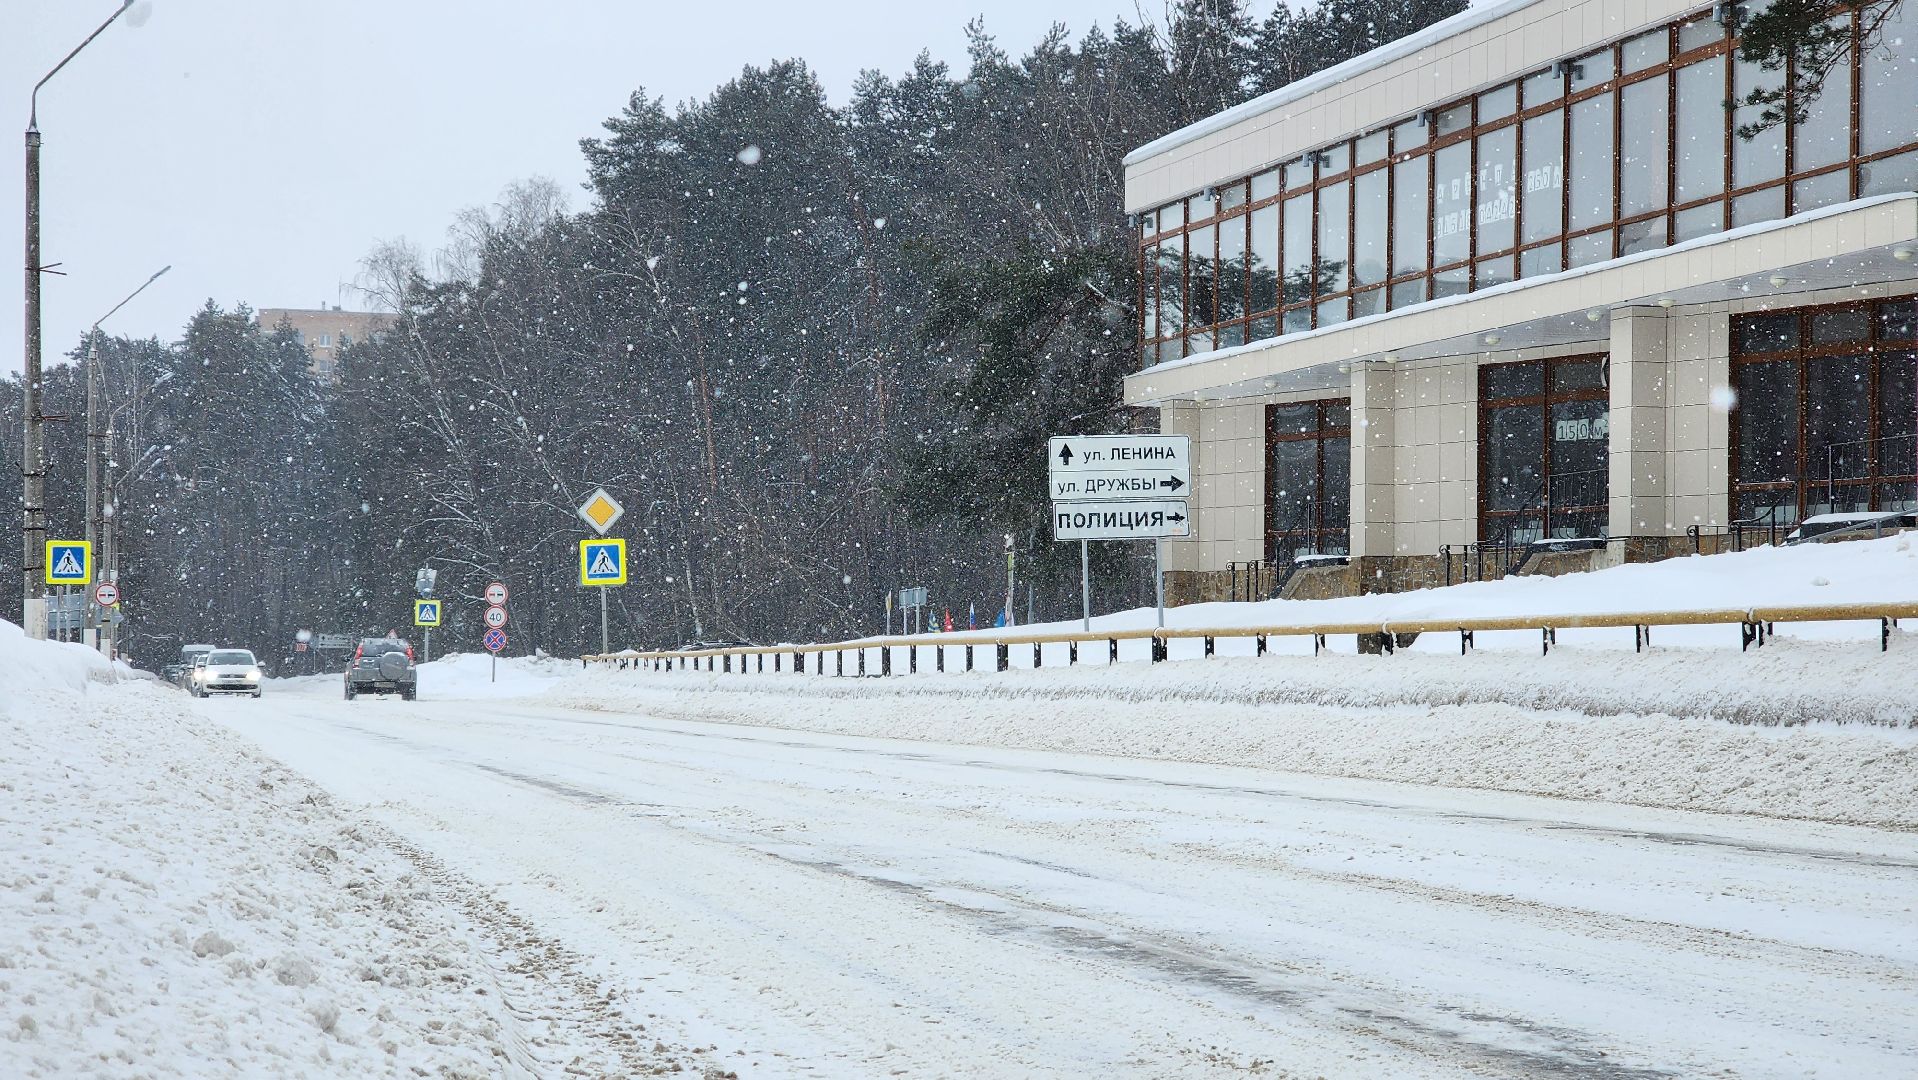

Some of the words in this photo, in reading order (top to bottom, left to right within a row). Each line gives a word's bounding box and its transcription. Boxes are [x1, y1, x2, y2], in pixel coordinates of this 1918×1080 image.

[1558, 424, 1588, 439] 150
[1083, 450, 1106, 464] ул.
[1110, 447, 1176, 460] ЛЕНИНА
[1058, 482, 1080, 495] ул.
[1085, 477, 1156, 494] ДРУЖБЫ
[1058, 511, 1164, 530] ПОЛИЦИЯ
[489, 612, 502, 622] 40
